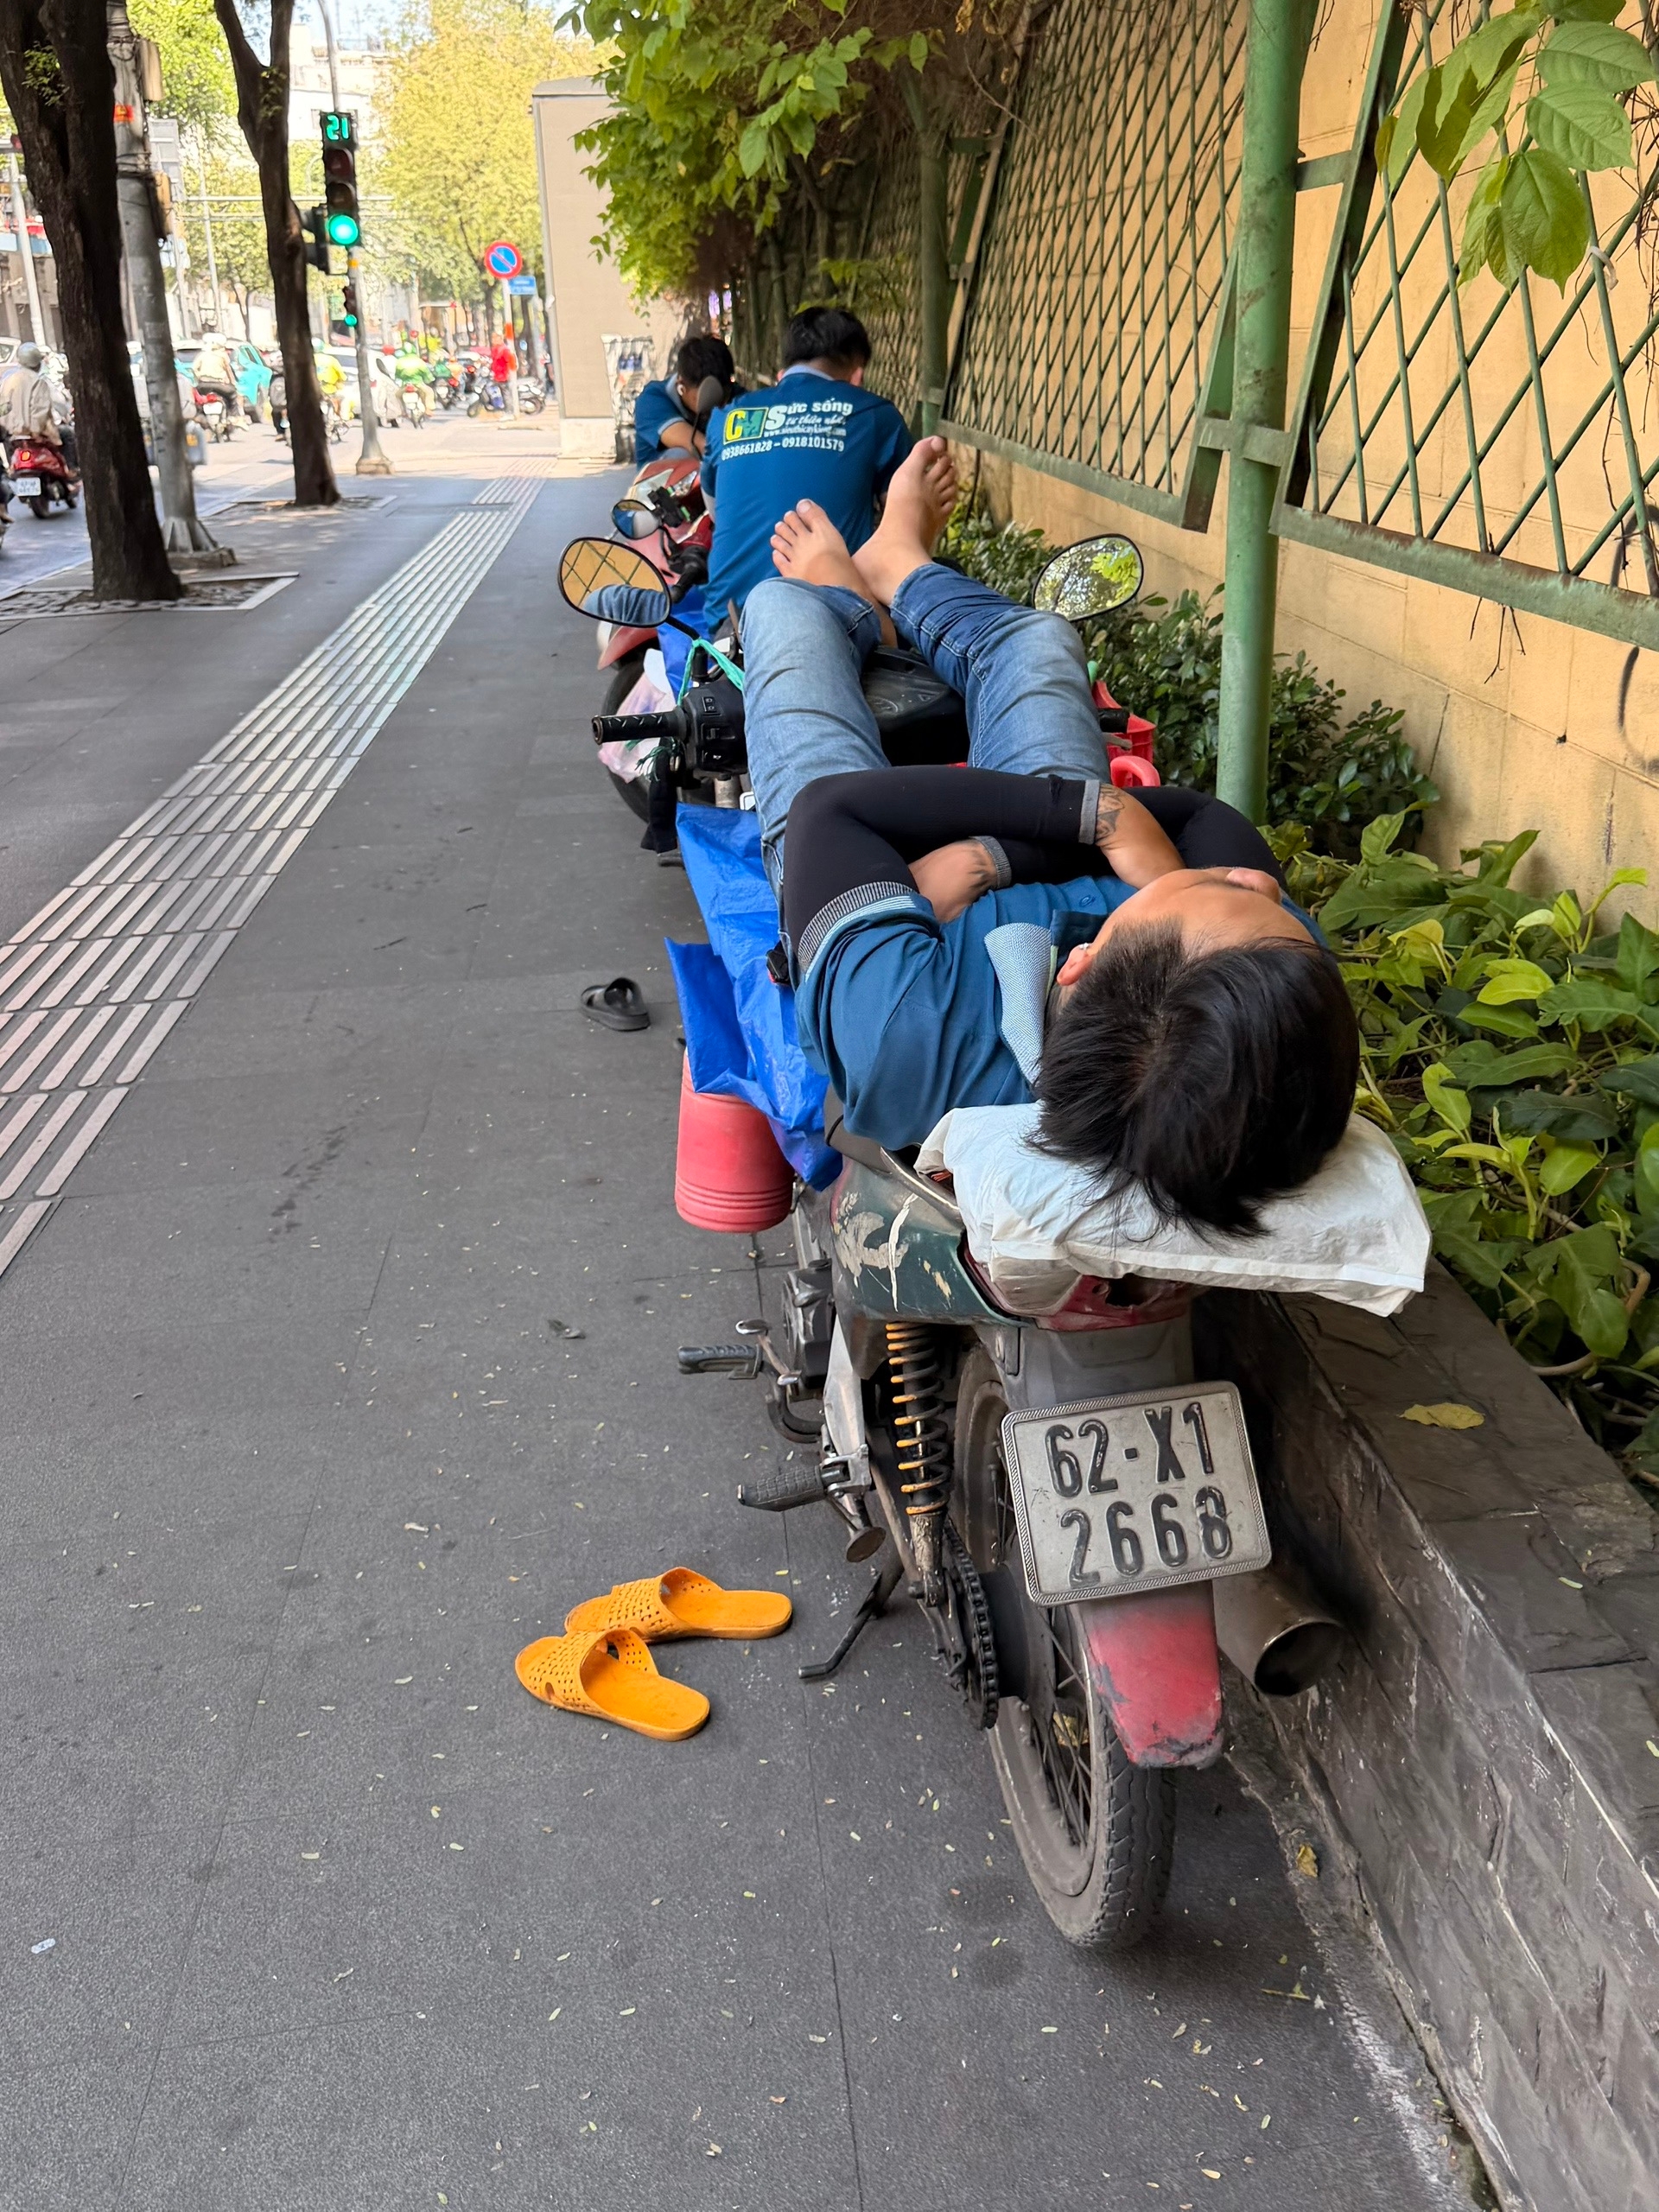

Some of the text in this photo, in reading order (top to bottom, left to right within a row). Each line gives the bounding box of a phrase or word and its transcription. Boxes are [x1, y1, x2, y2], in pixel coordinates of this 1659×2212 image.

[327, 115, 349, 140] 21
[811, 397, 854, 416] sống
[721, 440, 773, 461] 0938661828
[782, 436, 845, 452] 0918101579
[1044, 1402, 1215, 1498] 62-X1
[1060, 1485, 1234, 1589] 2668
